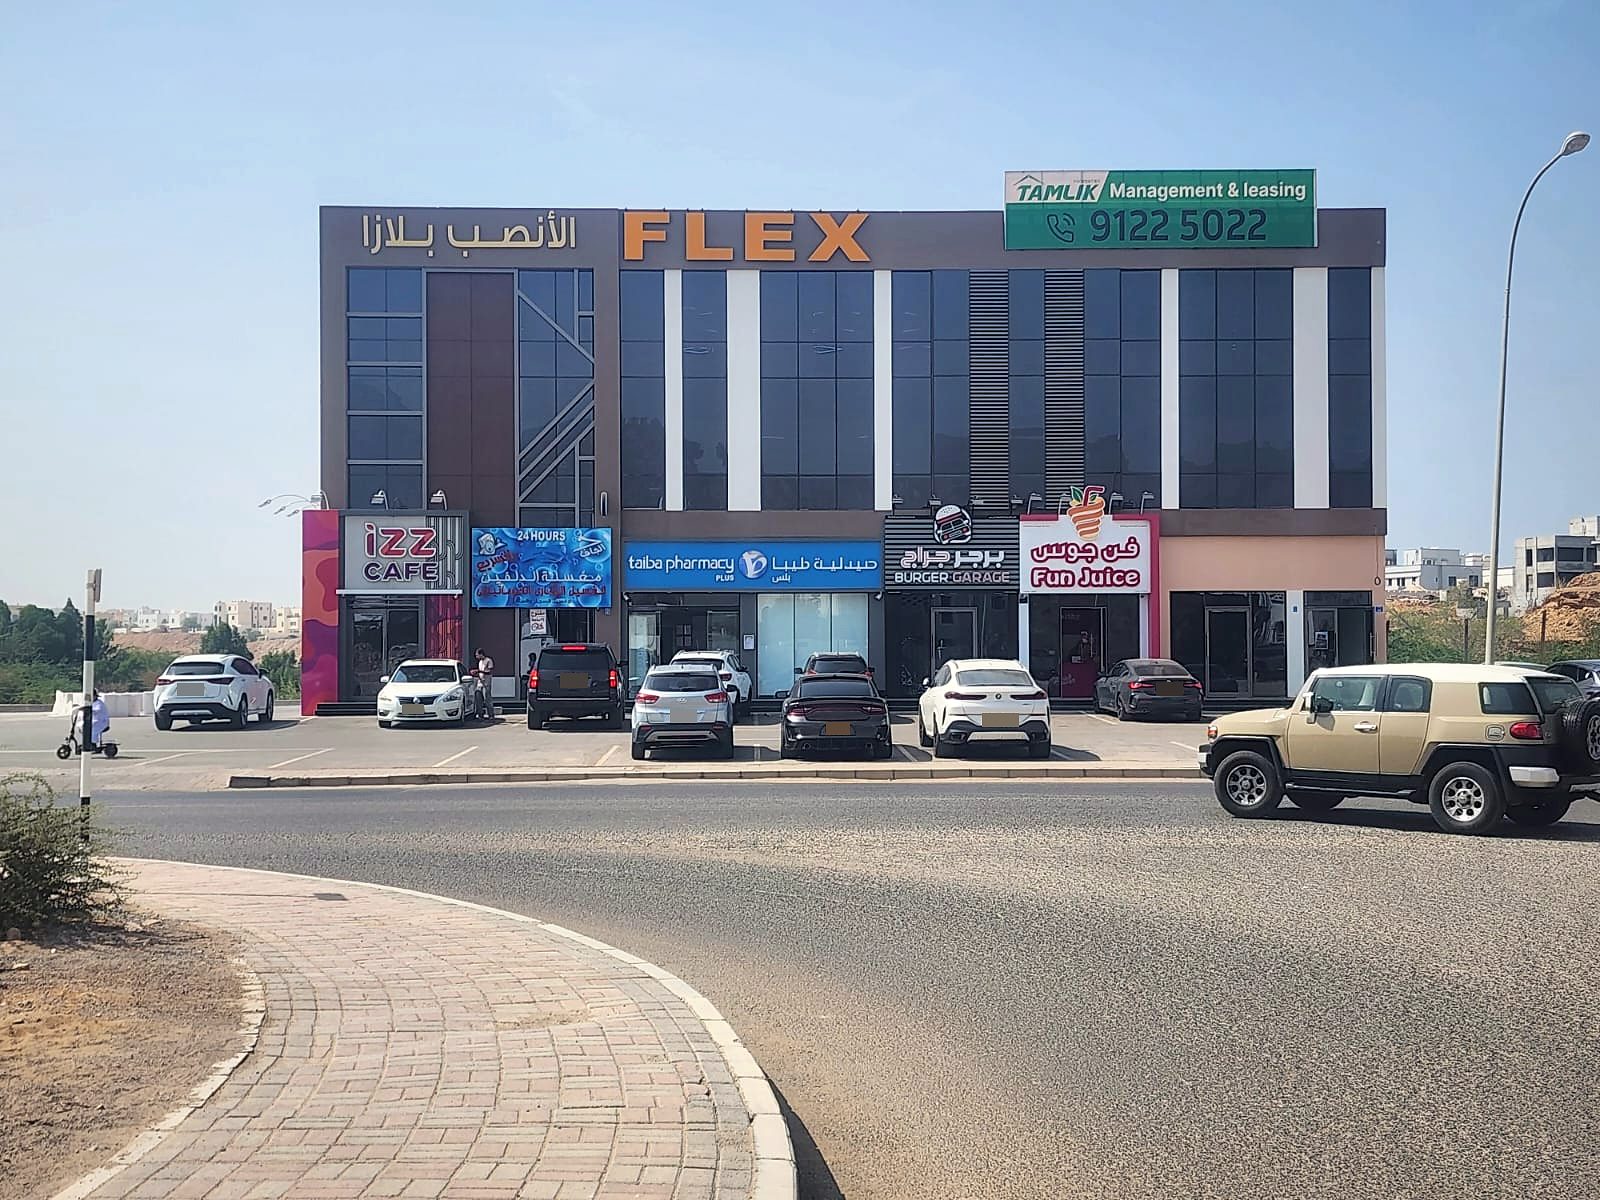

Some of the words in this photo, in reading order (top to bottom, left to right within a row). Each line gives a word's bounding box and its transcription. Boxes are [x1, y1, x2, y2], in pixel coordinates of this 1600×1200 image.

[1016, 184, 1099, 201] TAMLIK
[1109, 182, 1223, 201] Management
[1227, 182, 1239, 198] &
[1244, 181, 1306, 201] leasing
[447, 210, 576, 257] الأنصب
[1091, 209, 1169, 242] 9122
[1180, 208, 1267, 241] 5022
[362, 215, 434, 257] بلازا
[623, 211, 872, 262] FLEX
[517, 530, 530, 541] 24
[530, 530, 566, 541] HOURS
[900, 545, 951, 569] جراج
[953, 550, 1005, 569] برجر
[1031, 542, 1098, 564] جوس
[1101, 536, 1141, 563] فن
[362, 561, 439, 583] CAFE
[628, 554, 663, 570] taiba
[665, 554, 735, 574] pharmacy
[772, 556, 811, 572] طيبا
[813, 556, 878, 572] صيدلية
[715, 574, 735, 582] PLUS
[771, 573, 791, 583] بلس
[894, 572, 949, 583] BURGER
[952, 571, 1010, 583] GARAGE
[1031, 567, 1075, 587] Fun
[1078, 566, 1141, 587] Juice
